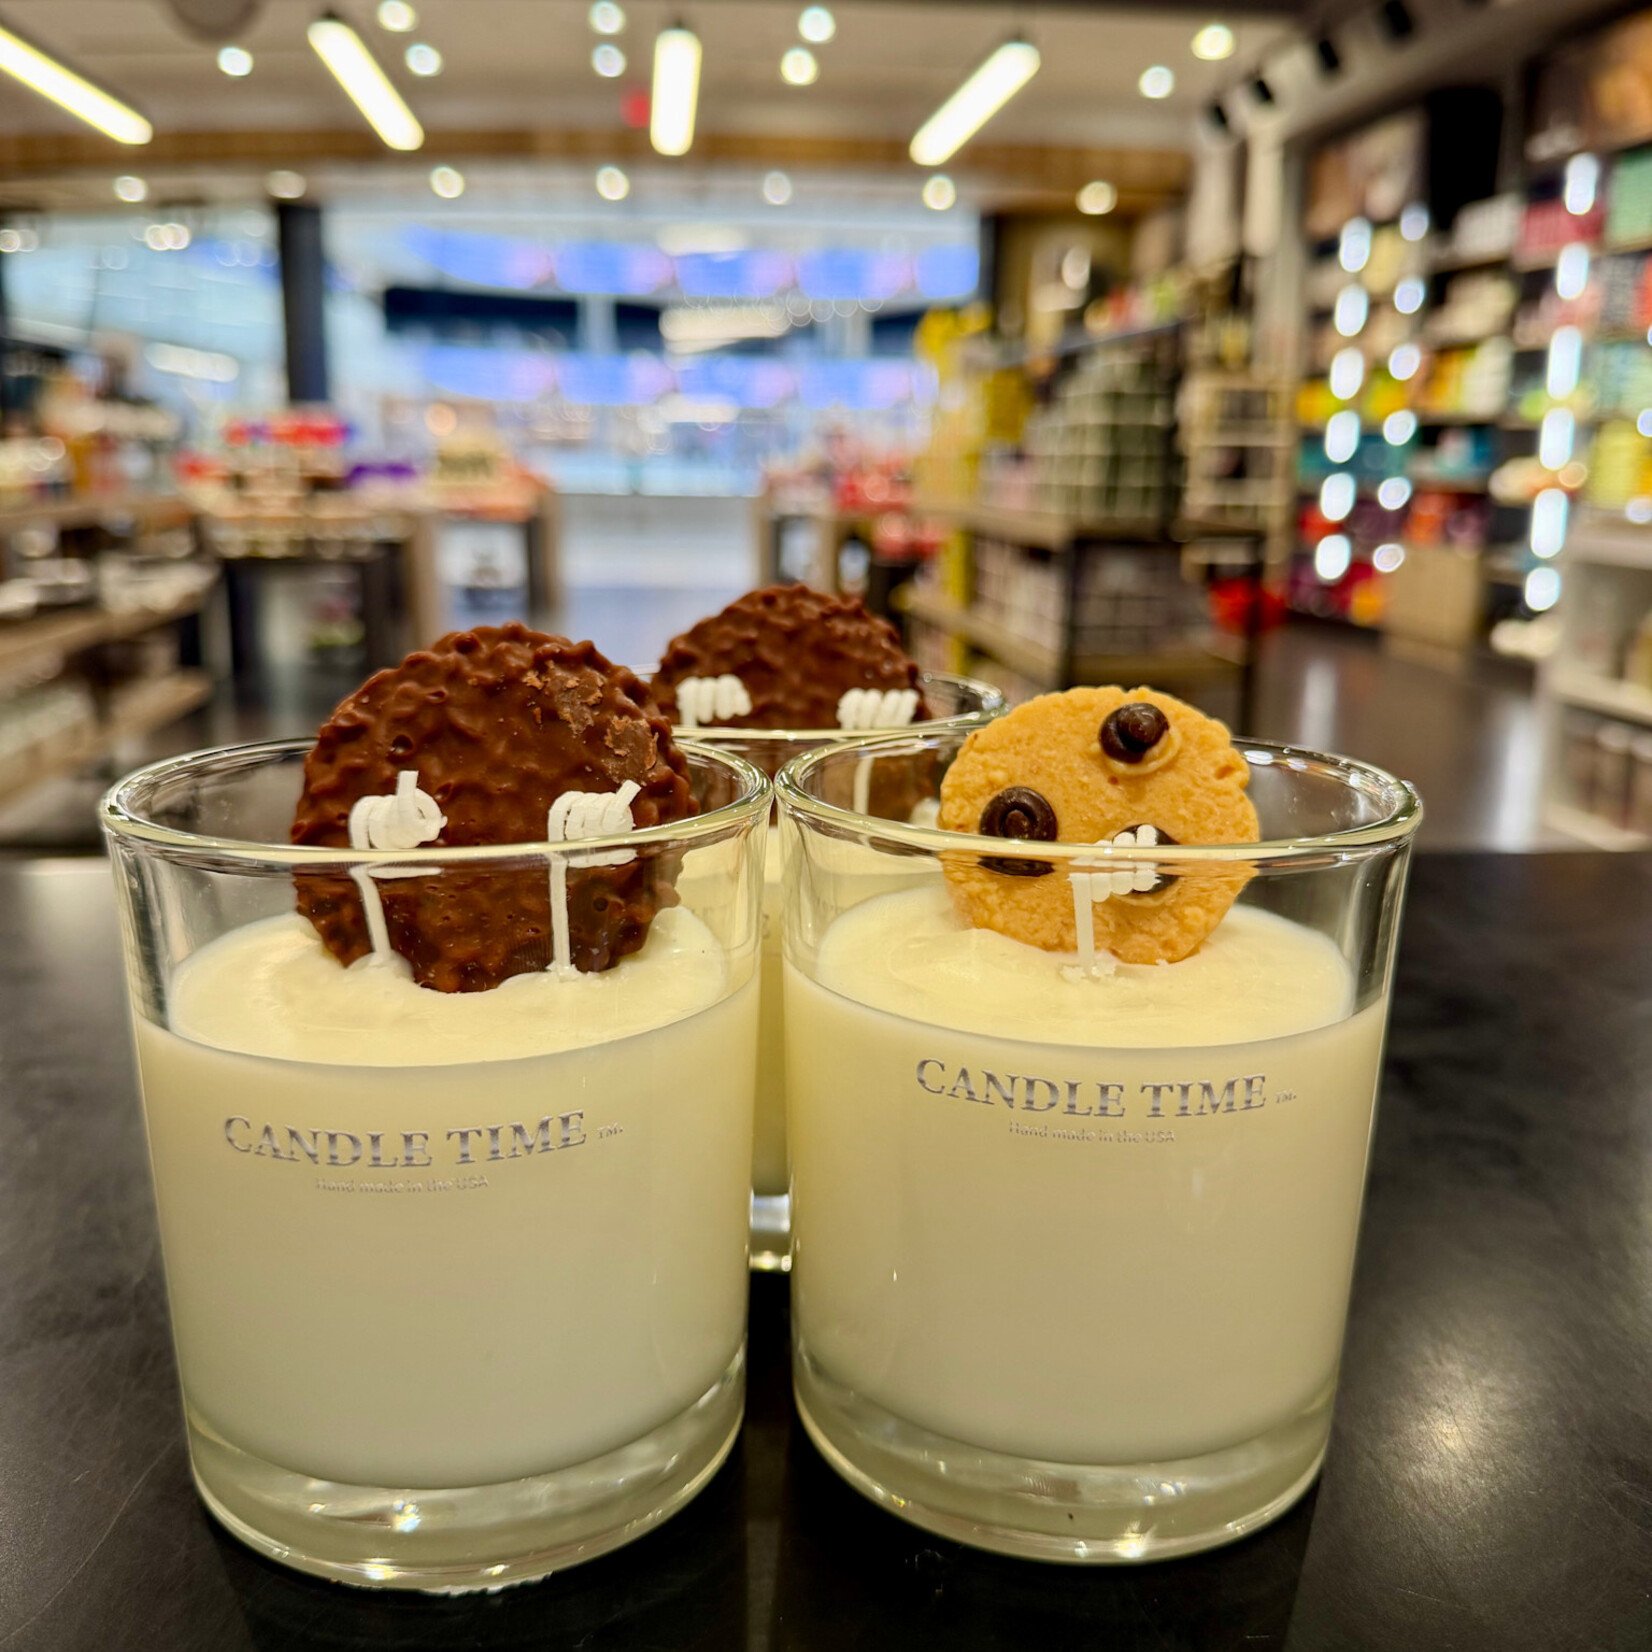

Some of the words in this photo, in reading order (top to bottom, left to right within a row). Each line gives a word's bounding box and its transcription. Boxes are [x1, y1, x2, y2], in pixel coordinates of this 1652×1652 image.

[916, 1059, 1125, 1117] CANDLE
[1140, 1075, 1266, 1117] TIME
[224, 1116, 432, 1167] CANDLE
[447, 1110, 586, 1164] TIME
[1009, 1121, 1047, 1137] Hand
[1052, 1126, 1096, 1141] made
[1099, 1127, 1113, 1141] in
[1117, 1128, 1143, 1143] the
[1145, 1128, 1175, 1143] USA
[314, 1176, 355, 1192] Hand
[359, 1177, 403, 1193] made
[407, 1178, 422, 1192] in
[426, 1177, 453, 1192] the
[456, 1174, 488, 1190] USA
